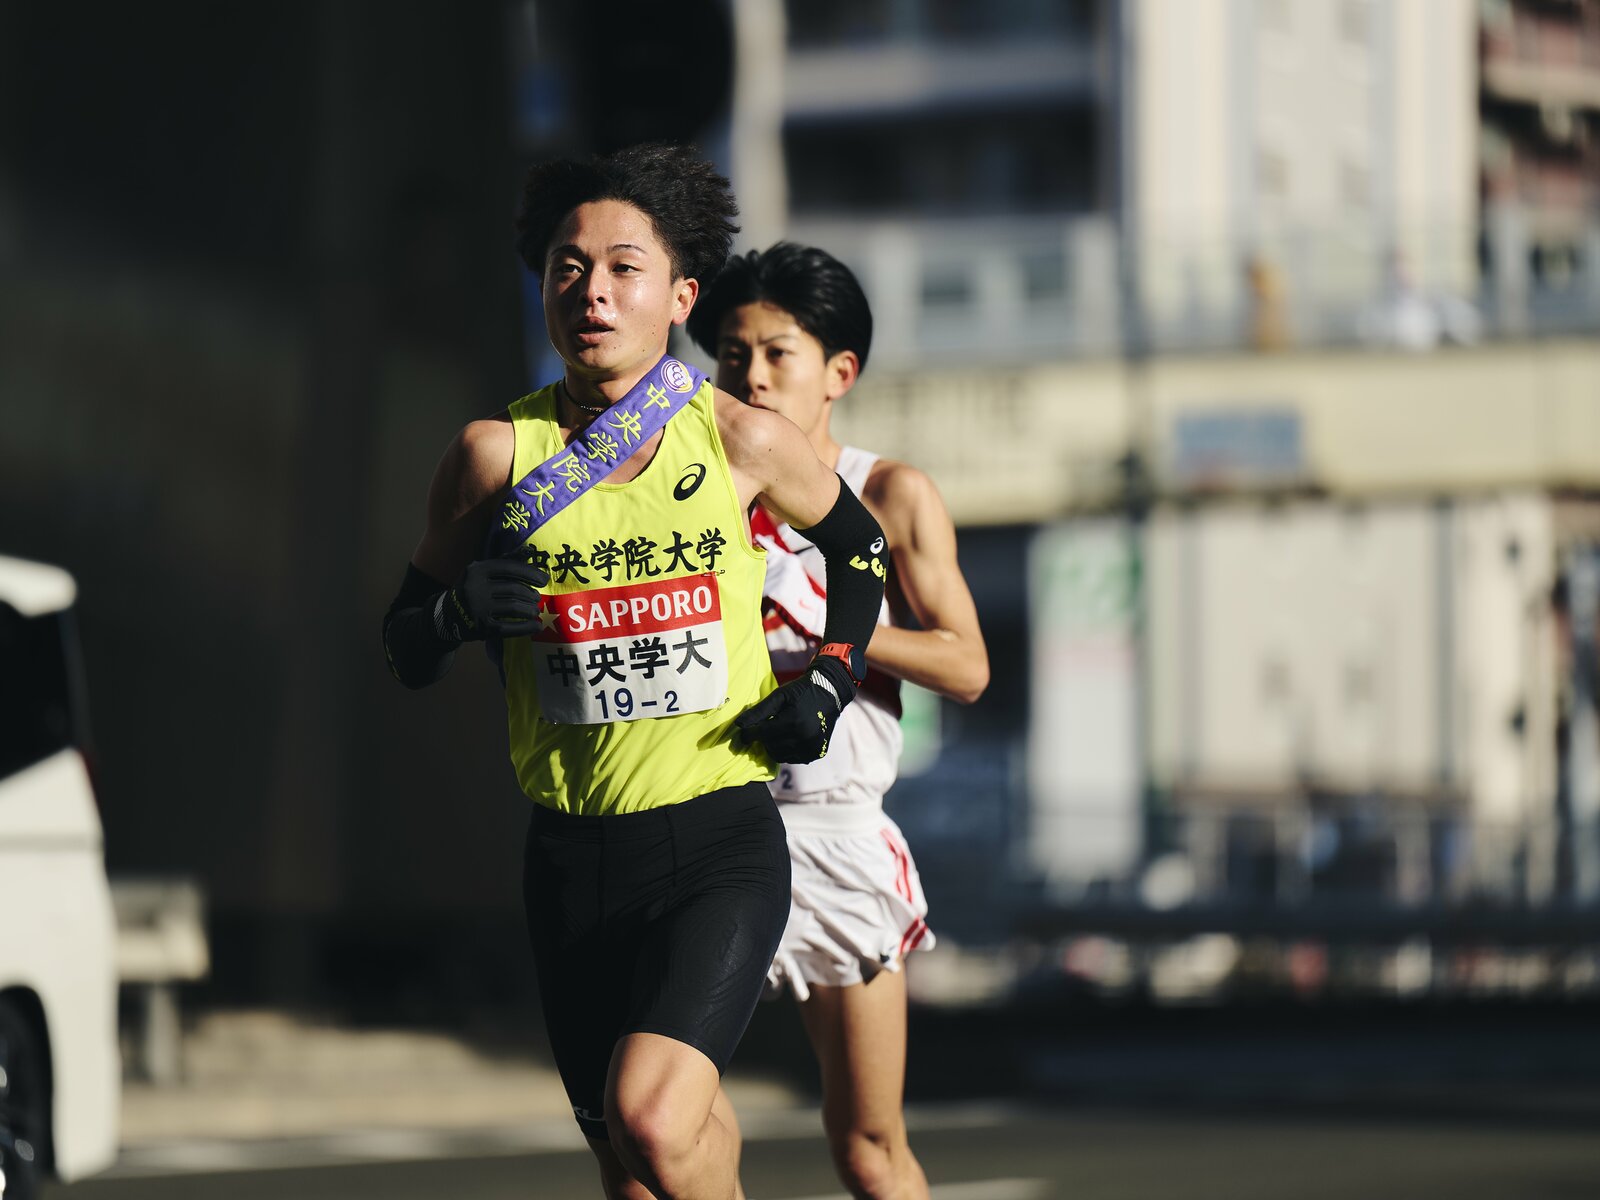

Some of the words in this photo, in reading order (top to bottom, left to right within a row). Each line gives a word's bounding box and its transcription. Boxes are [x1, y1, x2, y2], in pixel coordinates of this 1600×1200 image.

[502, 383, 670, 532] 中央学院大学
[567, 585, 713, 633] SAPPORO
[546, 630, 713, 687] 中央学大
[781, 768, 793, 790] 2
